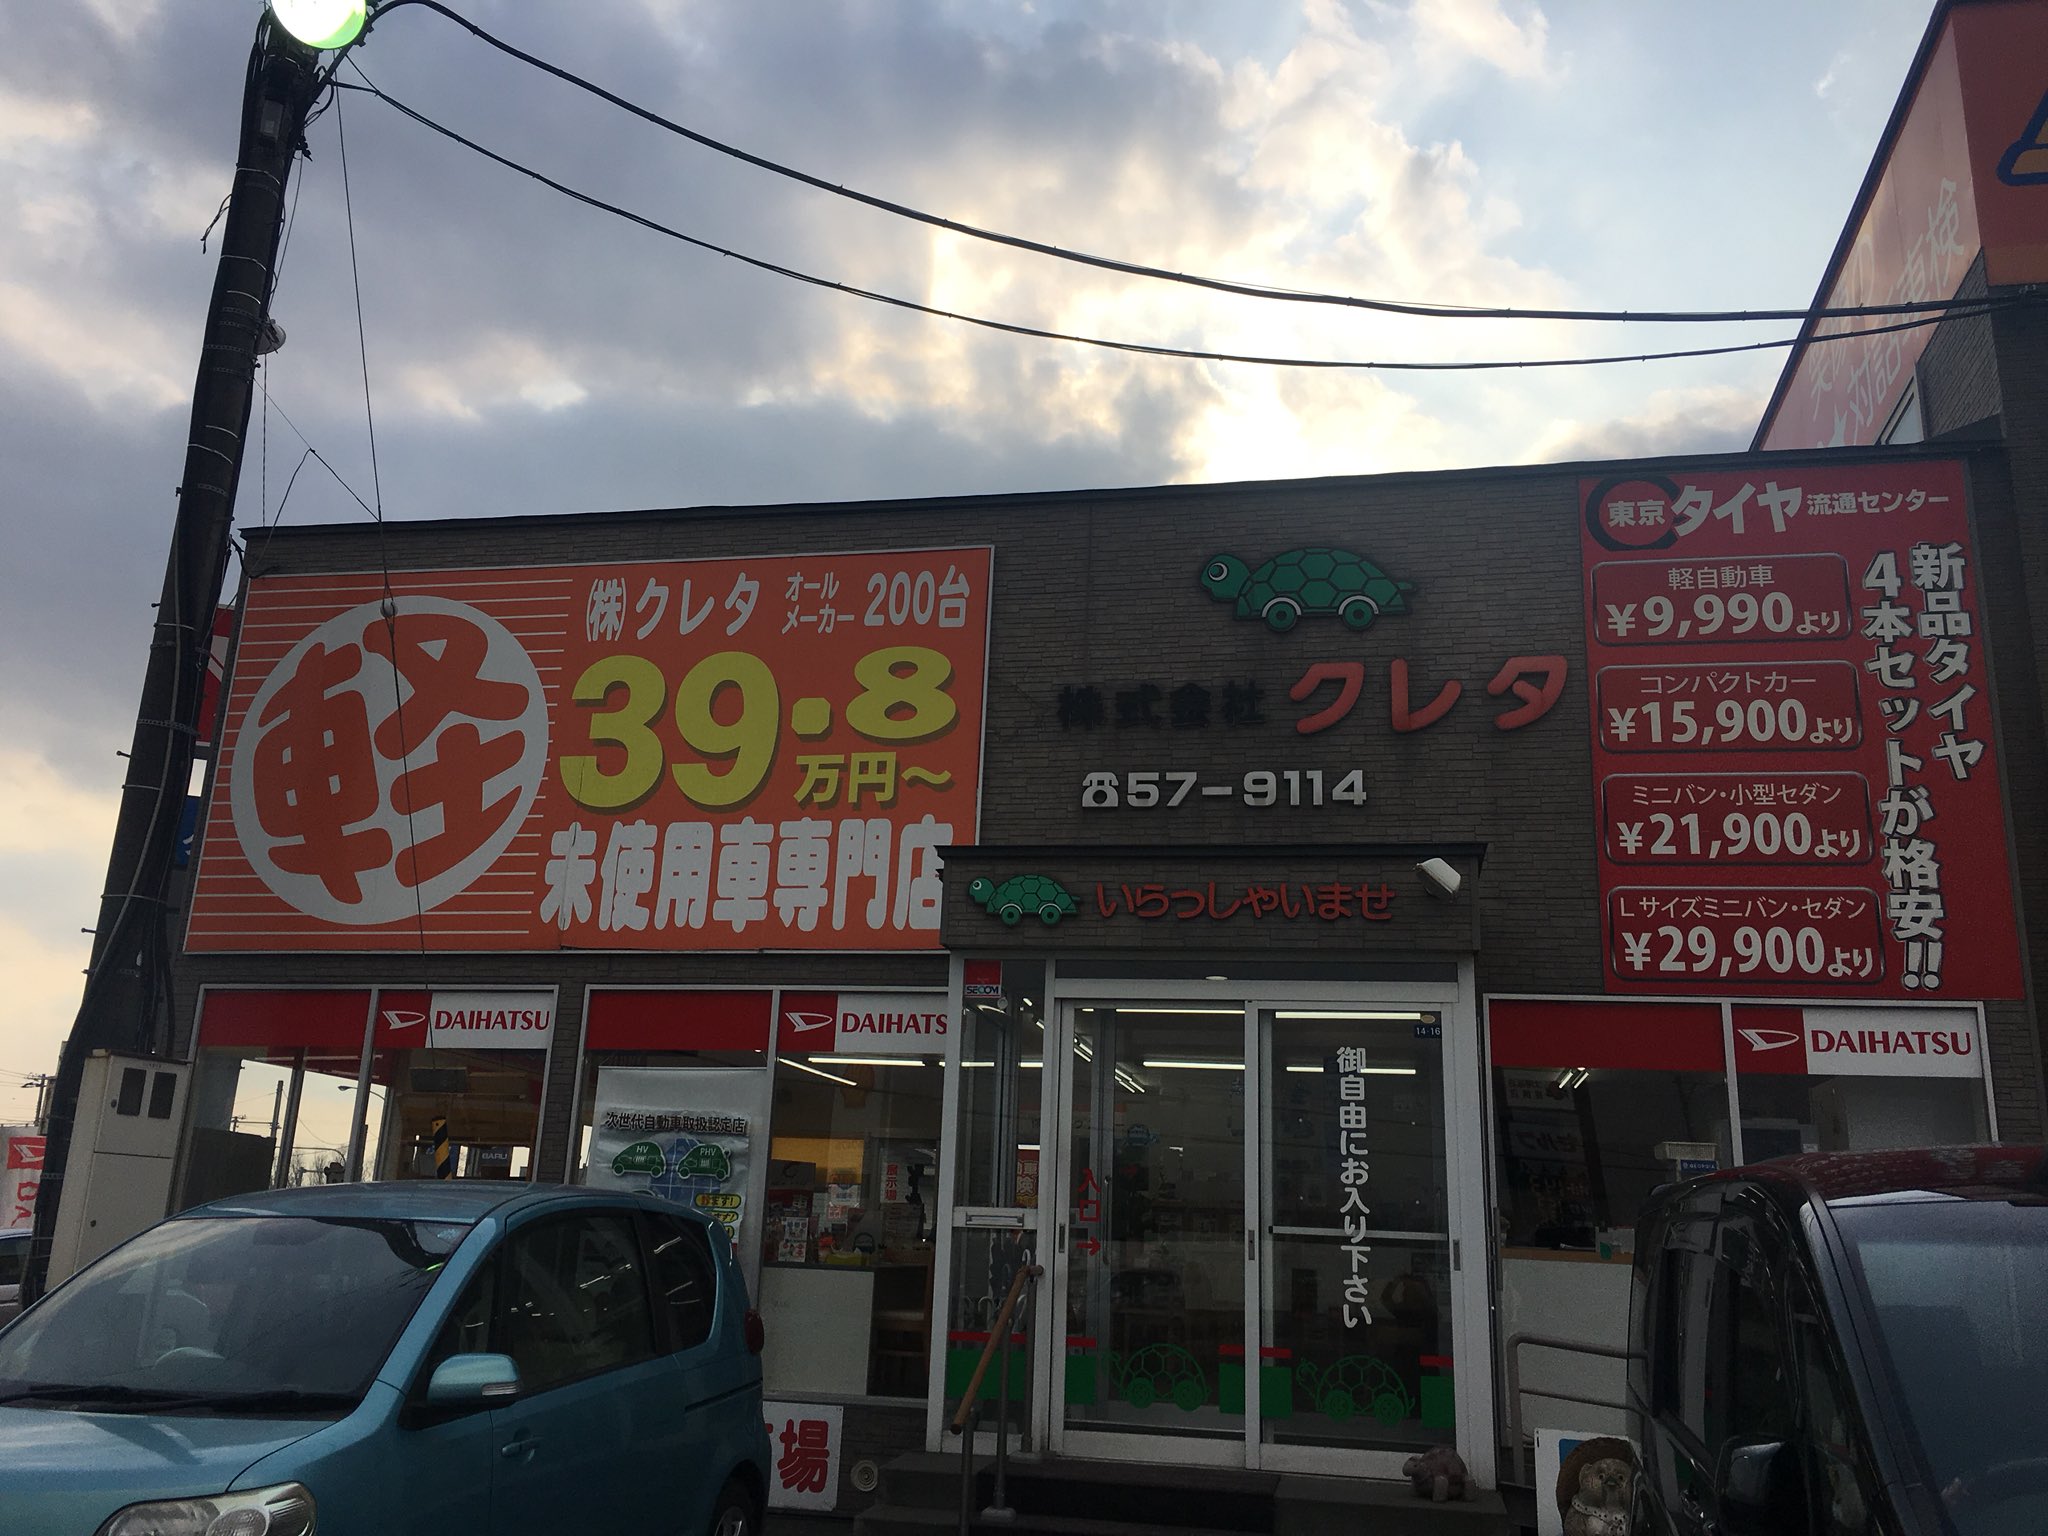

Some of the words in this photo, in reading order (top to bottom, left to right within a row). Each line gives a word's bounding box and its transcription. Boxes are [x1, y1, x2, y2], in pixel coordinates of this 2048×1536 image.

[785, 573, 840, 600] オール
[1667, 564, 1775, 590] 軽自動車
[864, 565, 971, 628] 200台
[781, 604, 856, 635] メーカー
[1909, 541, 1986, 782] 新品タイヤ
[1640, 671, 1817, 696] コンパクトカー
[252, 612, 531, 906] 軽
[1631, 782, 1842, 807] ミニバン・小型セダン
[540, 814, 955, 933] 未使用車専門店
[966, 985, 999, 994] SECOM
[434, 1009, 550, 1032] DAIHATSU
[841, 1012, 948, 1035] DAIHATS
[1811, 1031, 1972, 1057] DAIHATSU
[605, 1111, 747, 1133] 次世代自動車取扱認定店
[636, 1145, 649, 1153] HV
[1076, 1168, 1101, 1222] 入口
[1336, 1046, 1373, 1329] 御自由にお入り下さい
